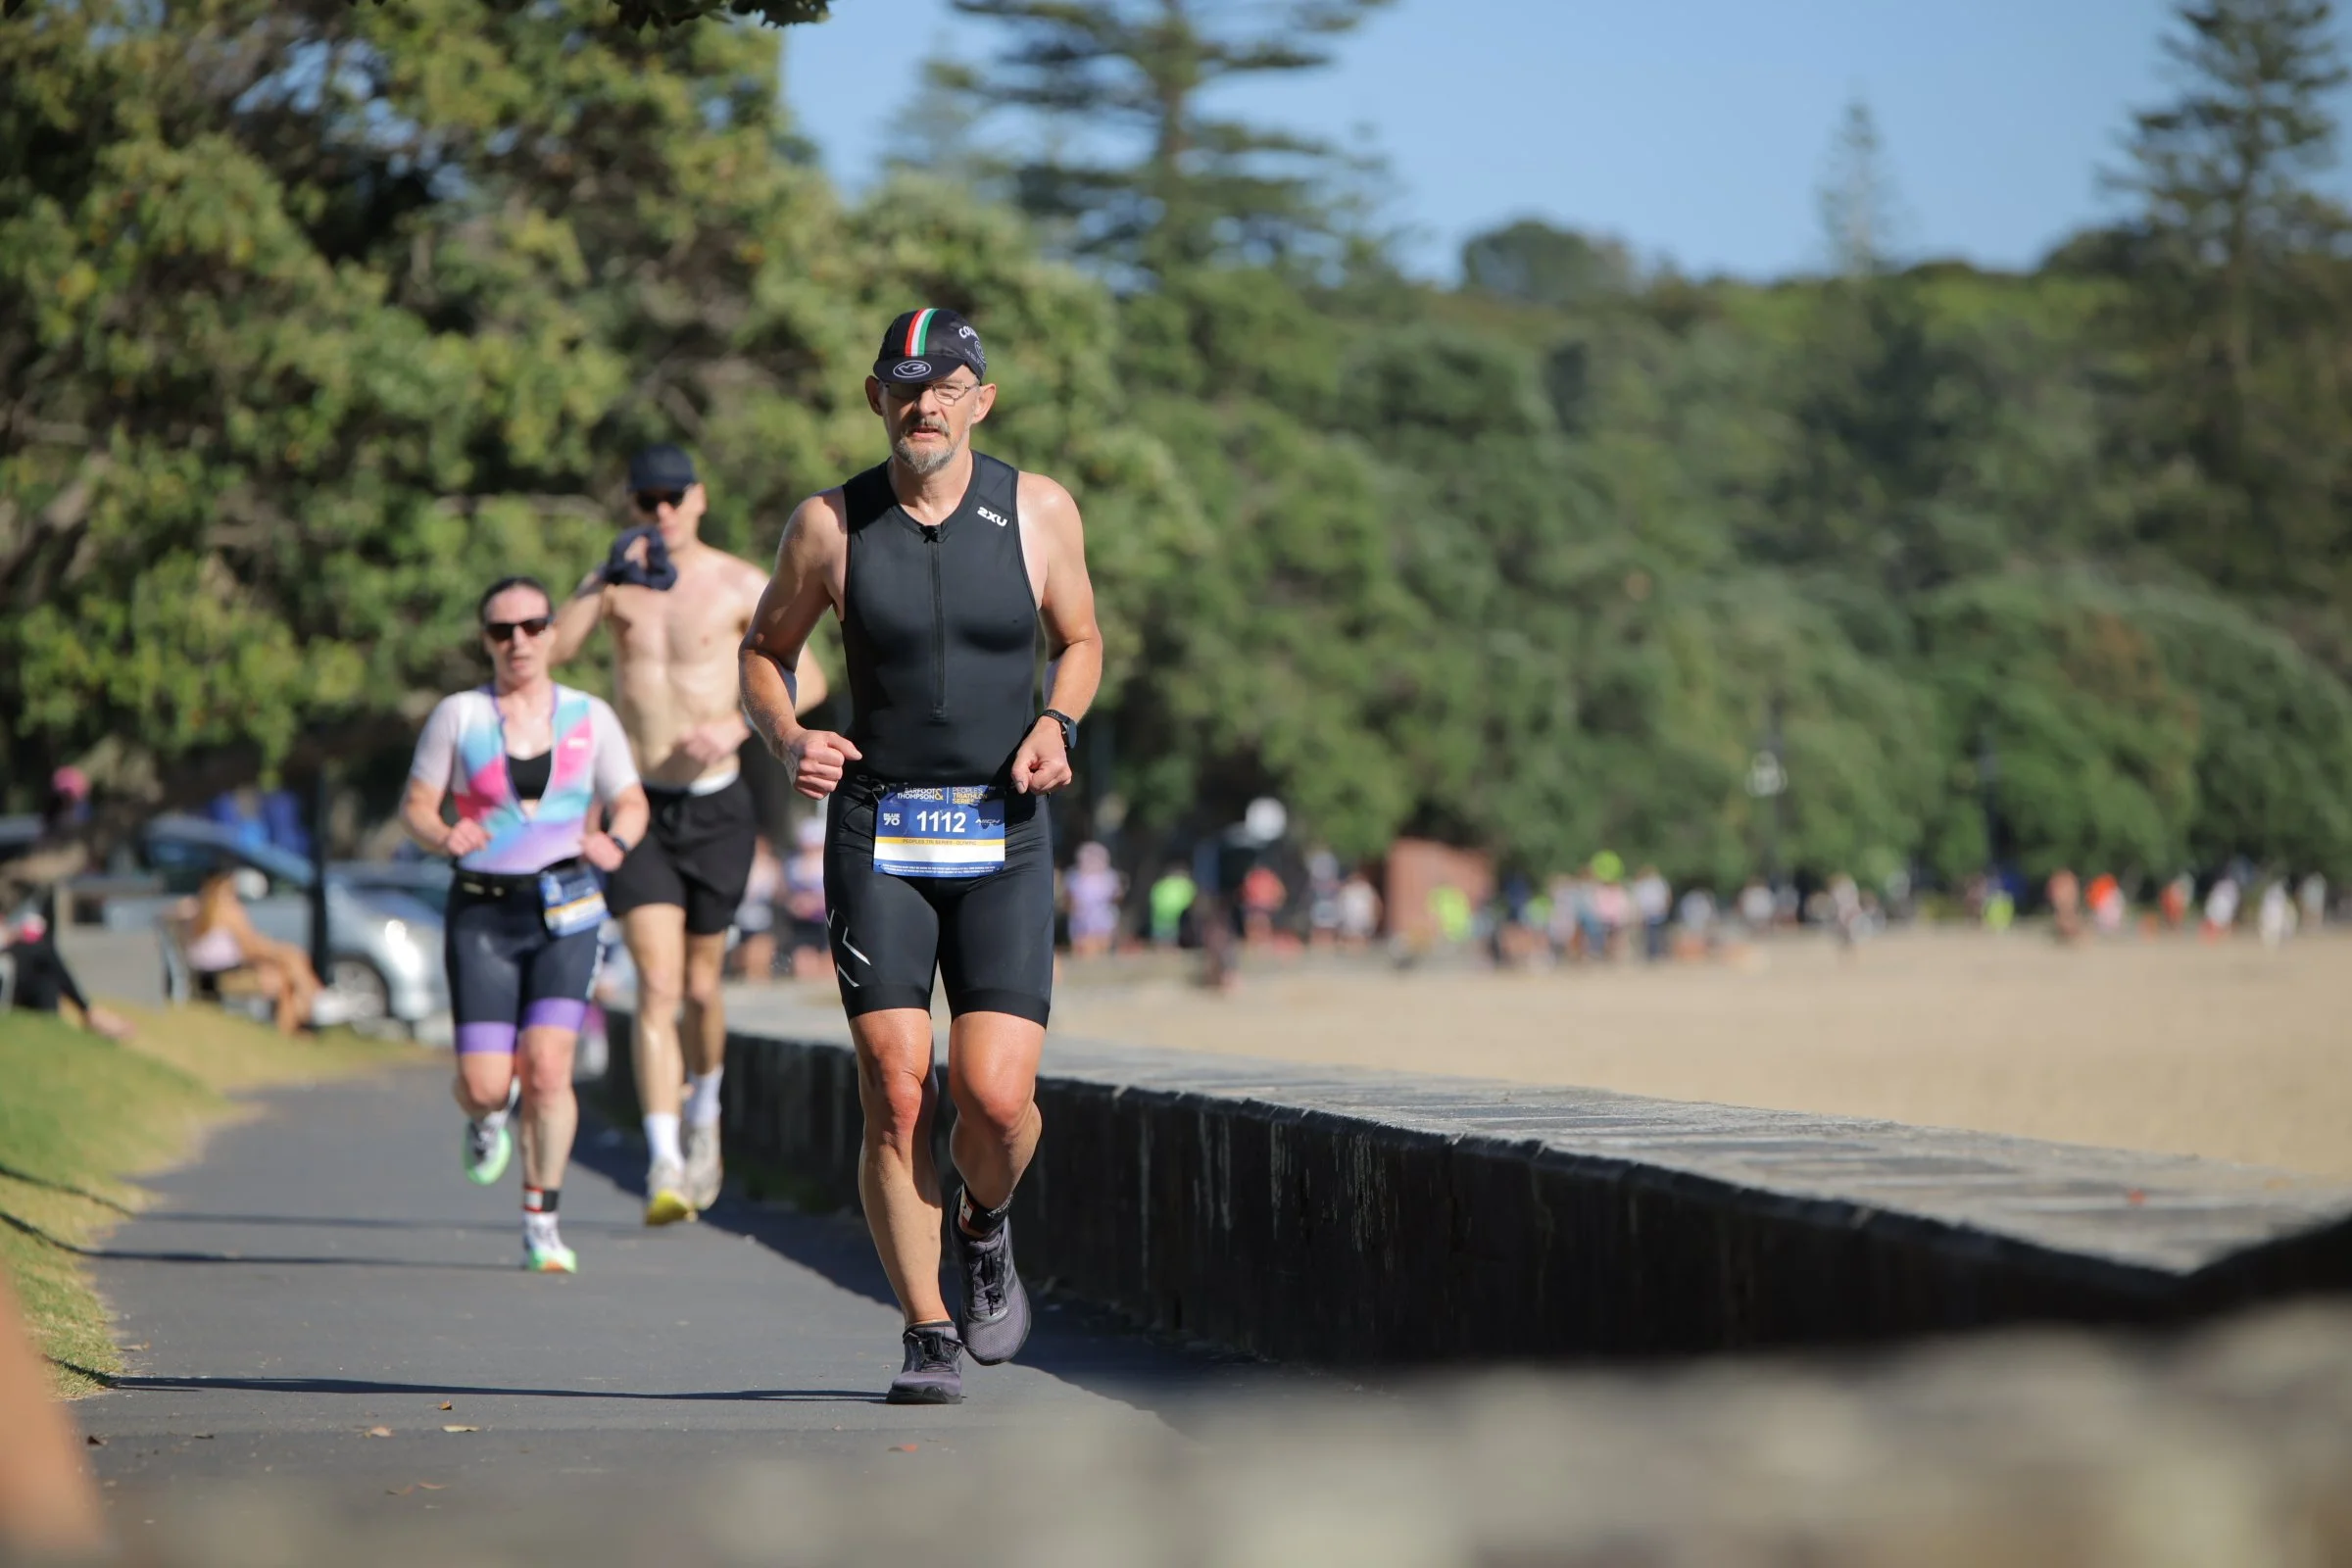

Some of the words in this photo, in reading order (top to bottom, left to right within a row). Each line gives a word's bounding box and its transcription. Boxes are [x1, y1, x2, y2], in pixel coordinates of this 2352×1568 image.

[977, 506, 1008, 527] 2XU
[935, 787, 944, 801] &
[883, 817, 901, 826] 70
[916, 810, 966, 833] 1112
